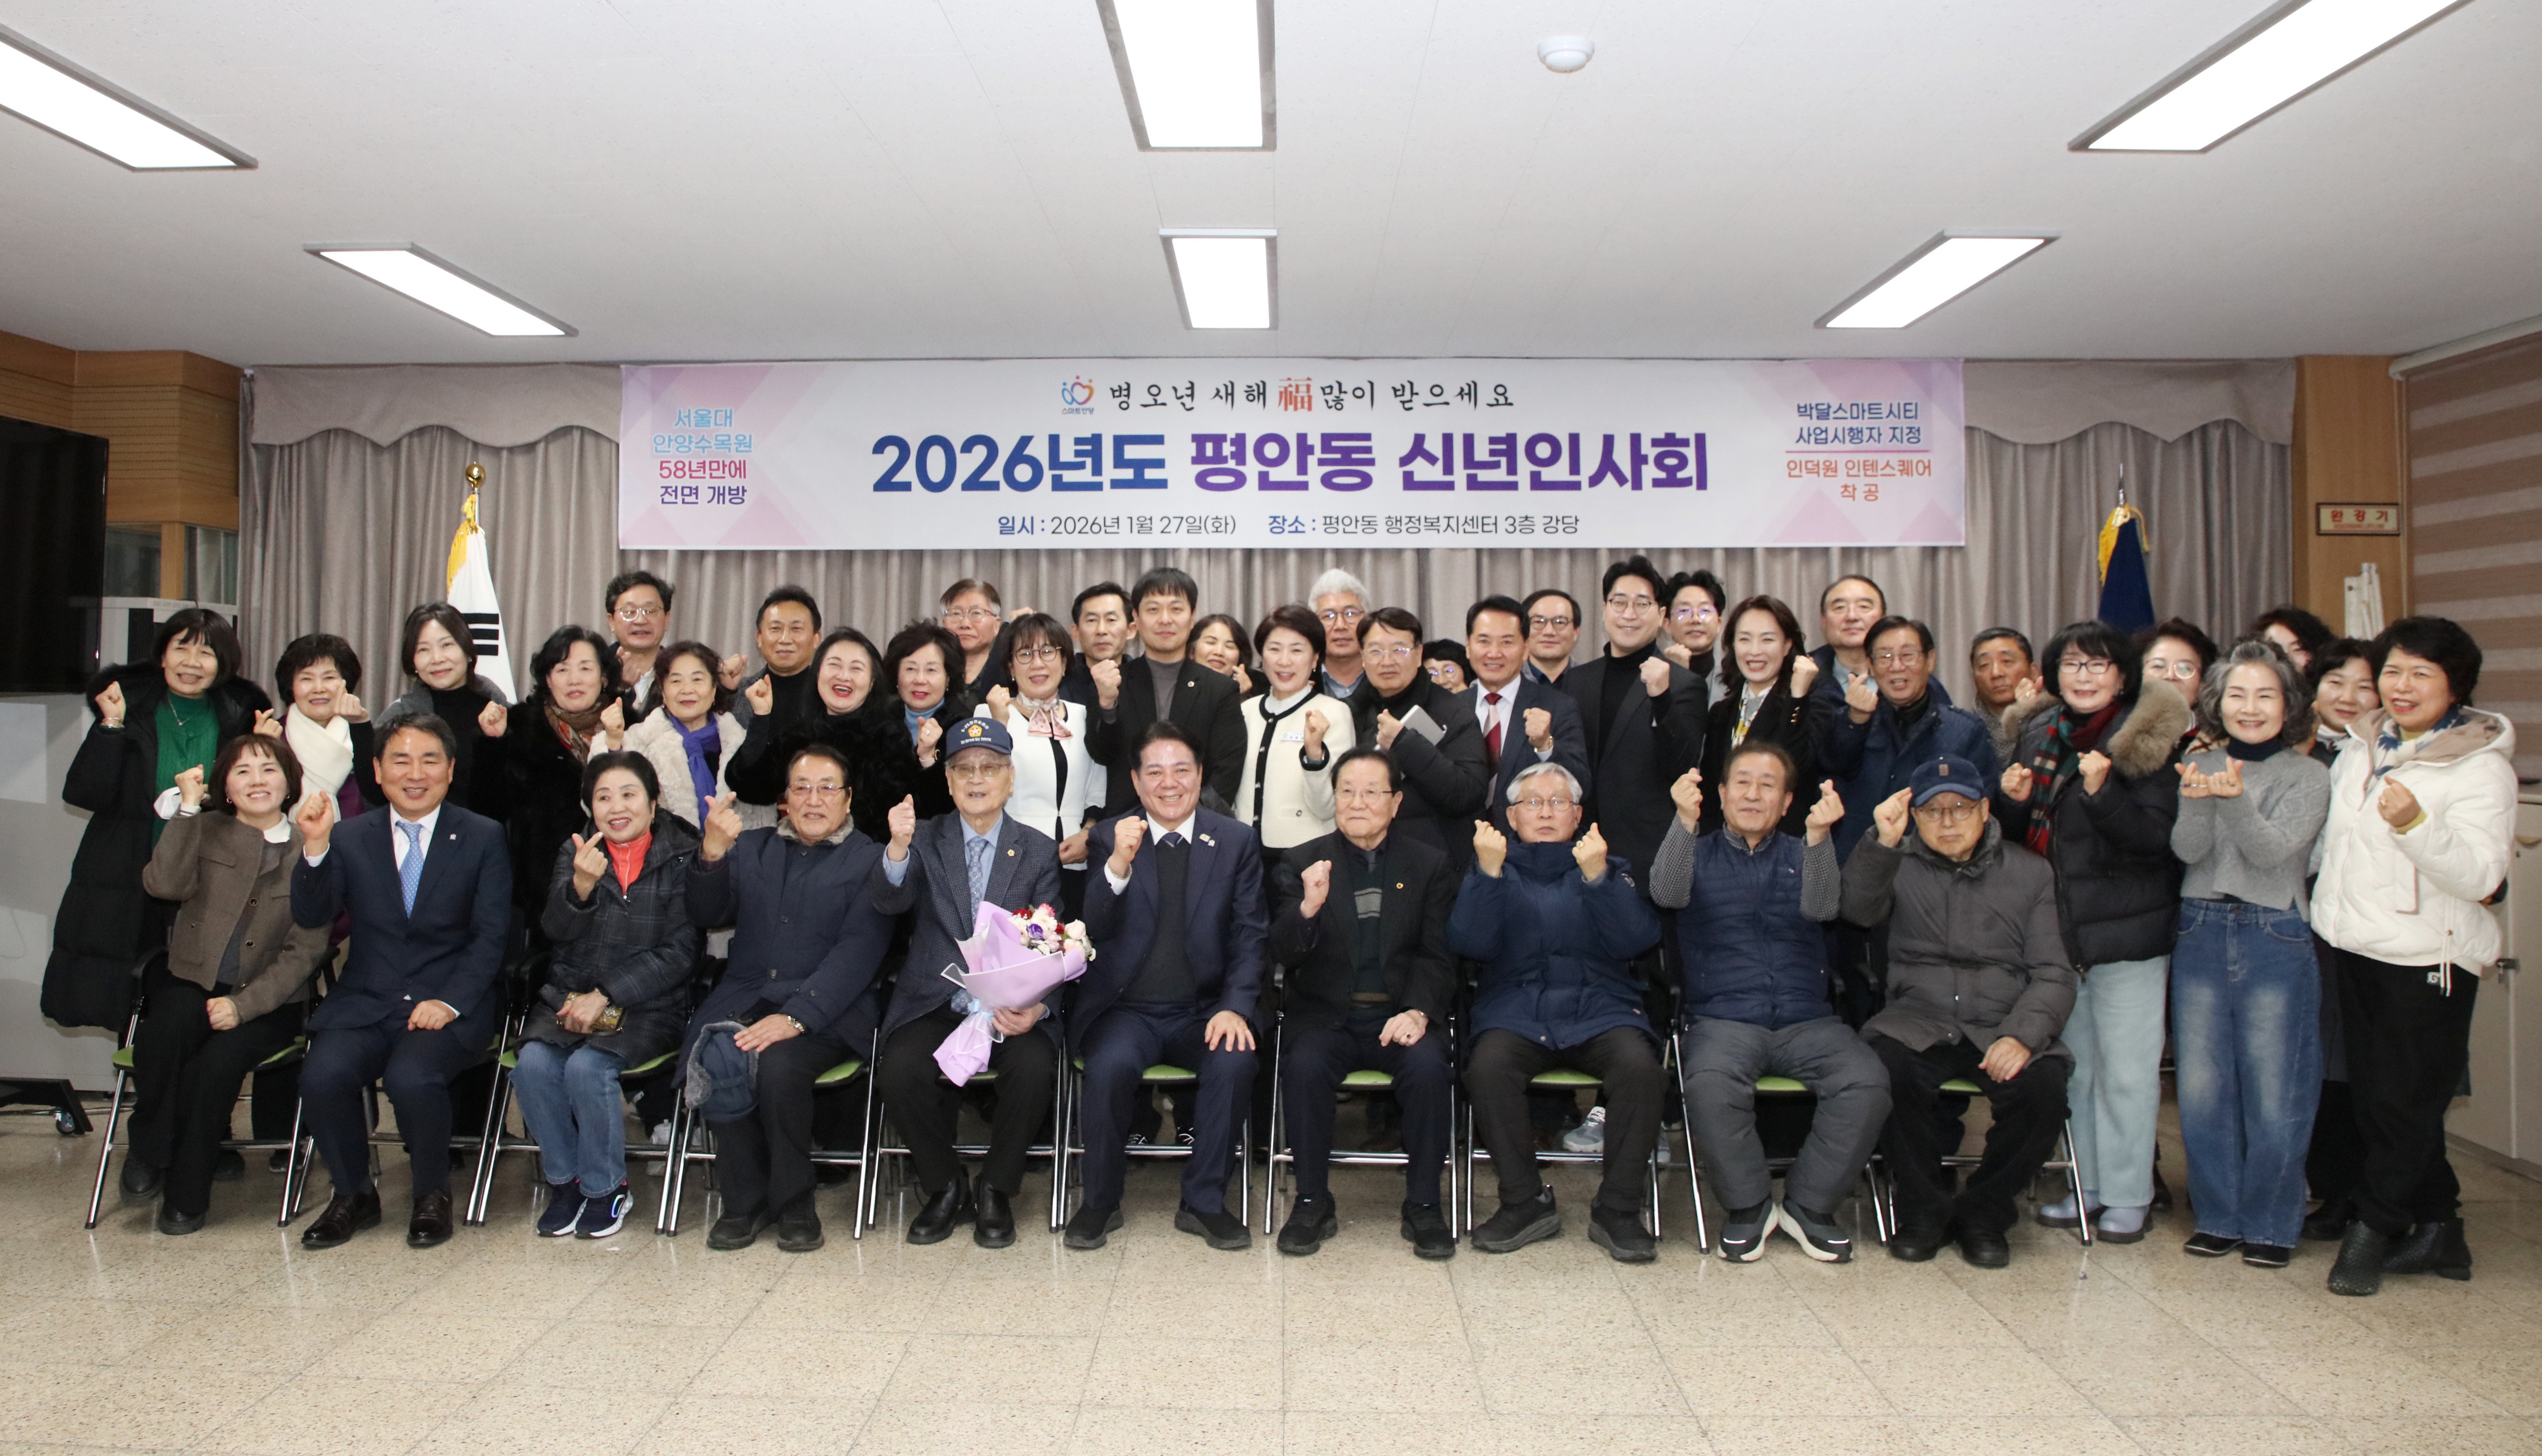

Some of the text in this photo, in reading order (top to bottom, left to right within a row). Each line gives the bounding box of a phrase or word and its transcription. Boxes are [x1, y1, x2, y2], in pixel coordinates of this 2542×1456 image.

[1213, 380, 1266, 409] 새해
[1320, 380, 1375, 411] 많이
[1391, 380, 1514, 411] 받으세요
[674, 408, 733, 428] 서울대
[1796, 402, 1919, 421] 박달스마트시티
[653, 434, 753, 453] 안양수목원
[1795, 426, 1921, 445] 사업시행자 지정
[659, 460, 747, 479] 58년만에
[872, 432, 1707, 493] 2026년도 평안동 신년인사회
[1787, 459, 1931, 478] 인덕원 인텐스퀘어
[660, 485, 747, 505] 전면 개방
[1051, 516, 1120, 535] 2026년
[1127, 516, 1152, 534] 1월
[1160, 515, 1236, 535] 27일(화)
[1323, 516, 1378, 534] 평안동
[1385, 515, 1497, 534] 행정복지센터
[1505, 515, 1535, 534] 3층
[1543, 515, 1580, 534] 강당
